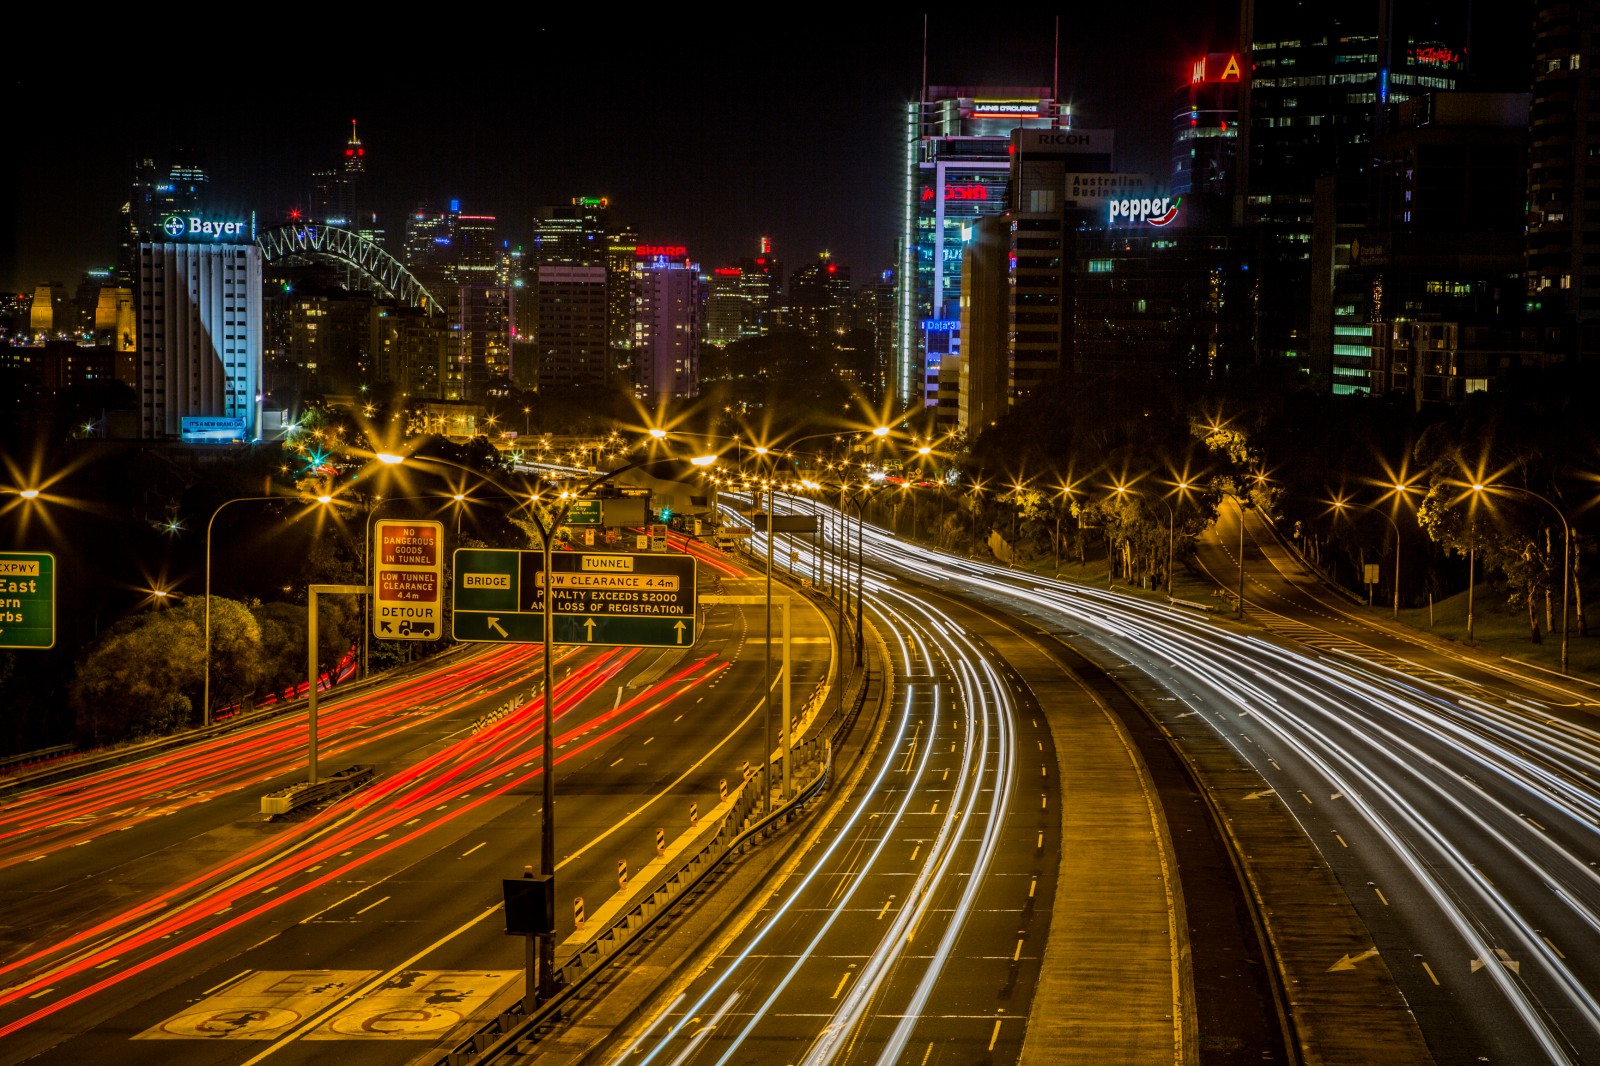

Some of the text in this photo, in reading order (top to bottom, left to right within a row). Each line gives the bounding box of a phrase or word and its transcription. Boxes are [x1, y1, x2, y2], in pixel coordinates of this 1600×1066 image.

[1000, 104, 1037, 112] O'ROURKE
[1038, 134, 1090, 145] RICOH
[1073, 175, 1142, 187] Australian
[1109, 197, 1170, 222] pepper
[188, 217, 243, 238] Bayer
[635, 246, 686, 256] SHARP
[403, 528, 415, 536] NO
[383, 536, 434, 546] DANGEROUS
[395, 546, 423, 554] GOODS
[399, 555, 431, 564] TUNNEL
[586, 558, 630, 569] TUNNEL
[381, 572, 436, 582] LOW TUNNEL
[466, 576, 507, 587] BRIDGE
[570, 576, 639, 588] CLEARANCE
[645, 578, 674, 588] 4.4m
[383, 581, 433, 591] CLEARANCE
[536, 590, 678, 603] PNALTY EXCEEDS $2000
[382, 607, 434, 618] DETOUR
[557, 602, 585, 612] LOSS
[590, 603, 604, 612] OF
[608, 603, 684, 615] REGISTRATION
